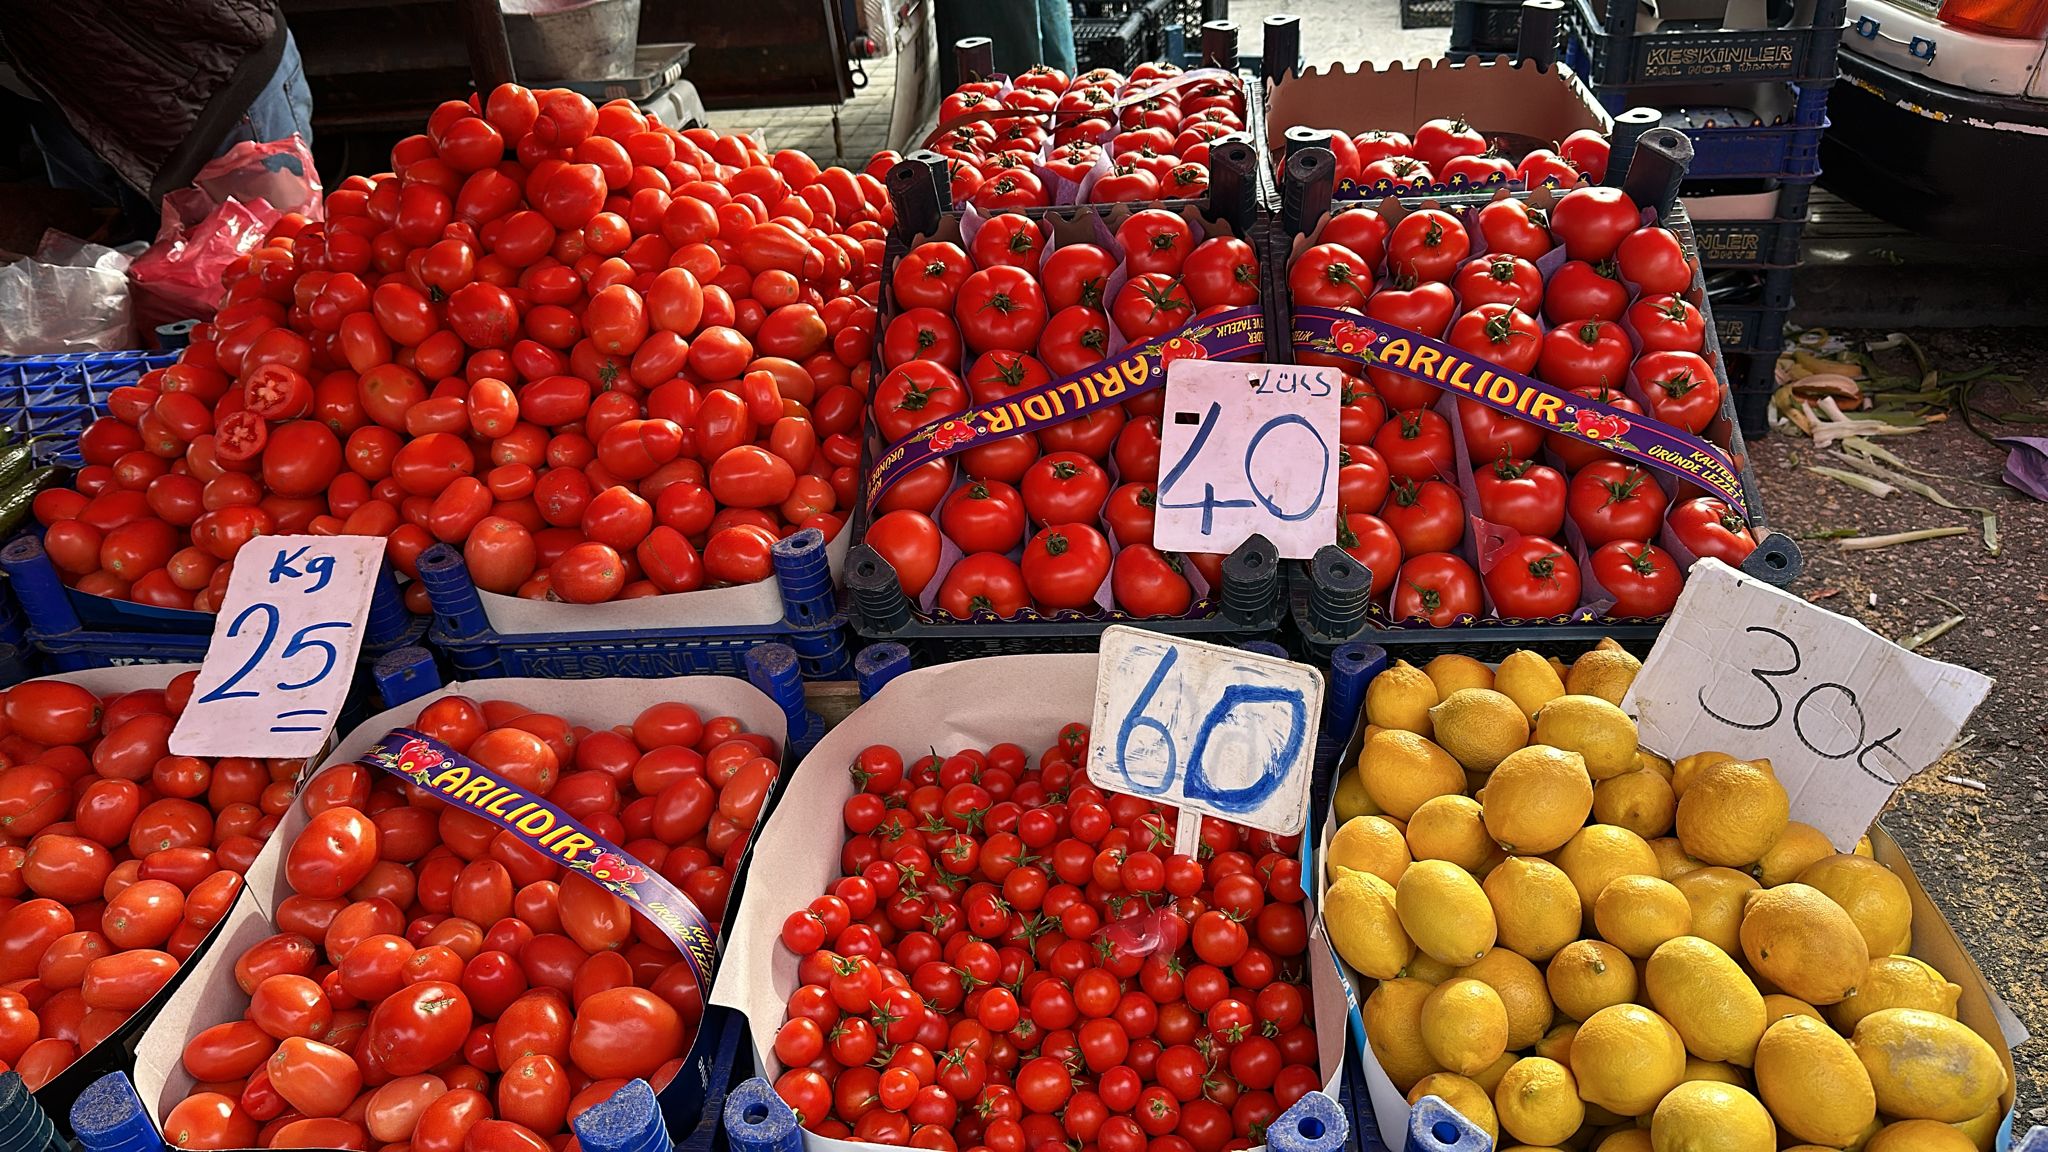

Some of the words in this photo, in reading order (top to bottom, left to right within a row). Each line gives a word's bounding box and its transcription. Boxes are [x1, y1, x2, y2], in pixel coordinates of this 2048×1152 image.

[979, 354, 1149, 433] ARILIDIR
[1379, 338, 1565, 425] ARILIDIR
[1158, 401, 1329, 535] 40
[1648, 445, 1703, 473] ÜRÜNDE
[269, 545, 336, 593] Kg
[198, 603, 352, 704] 25
[521, 651, 747, 678] KESKİNLE
[1116, 645, 1307, 813] 60
[430, 766, 597, 862] ARILIDIR
